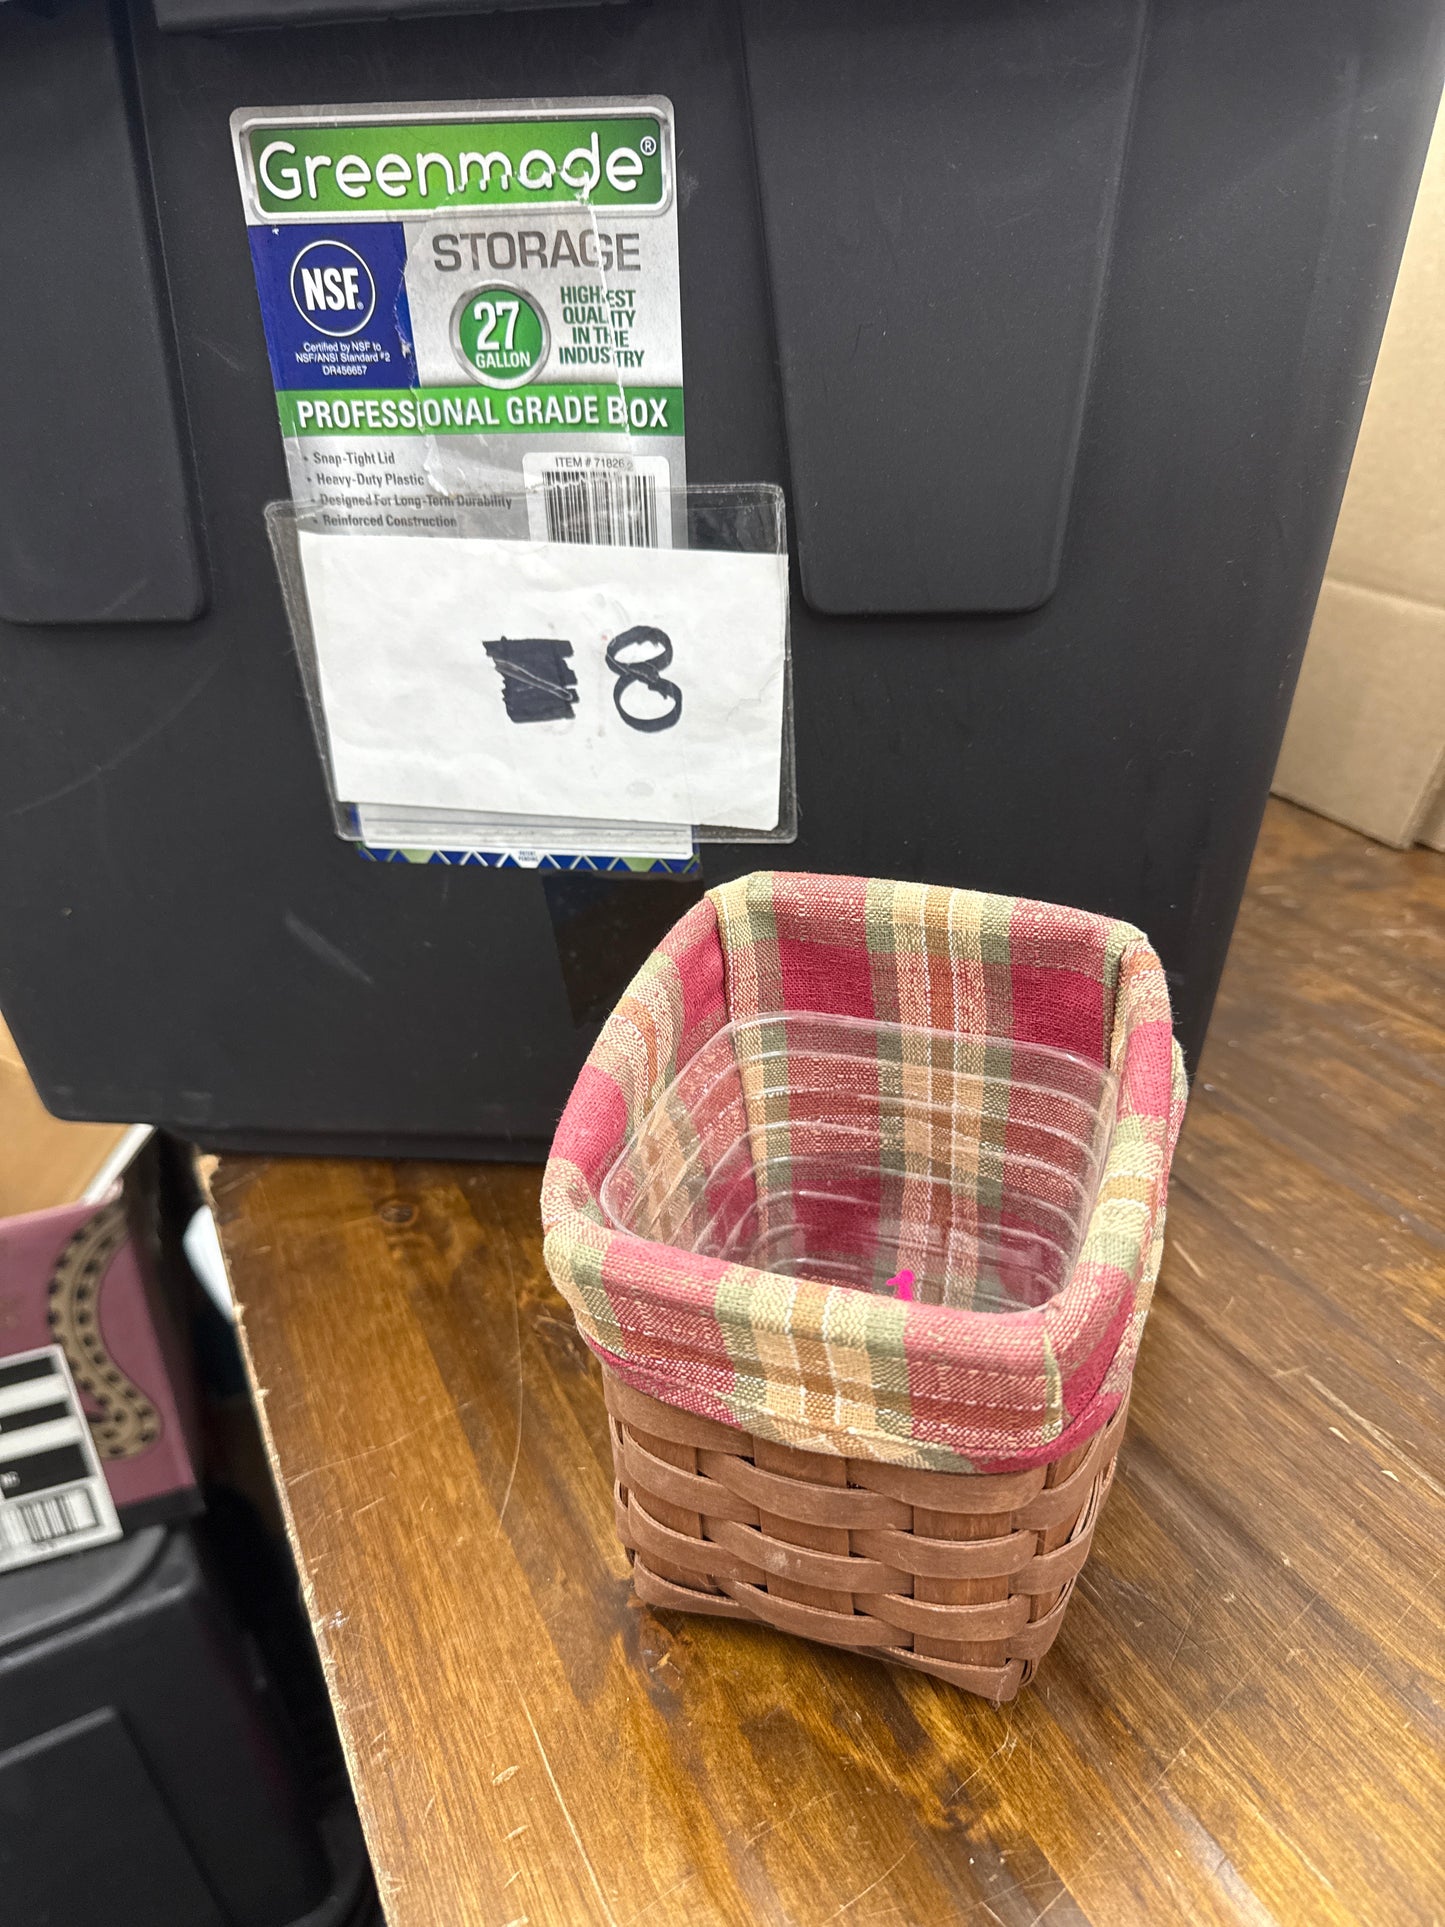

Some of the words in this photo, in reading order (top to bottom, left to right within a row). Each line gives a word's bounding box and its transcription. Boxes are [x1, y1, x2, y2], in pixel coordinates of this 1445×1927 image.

[432, 229, 641, 272] STORAGE
[560, 285, 636, 308] HIGHEST
[474, 301, 520, 351] 27
[562, 306, 636, 328] QUALITY
[572, 326, 590, 344] IN
[593, 326, 629, 348] THE
[303, 341, 338, 352] Certified
[340, 342, 351, 353] by
[351, 341, 370, 352] NSF
[372, 342, 381, 351] to
[295, 352, 339, 363] NSF/ANSI
[340, 352, 379, 362] Standard
[475, 352, 531, 369] GALLON
[559, 346, 645, 368] INDUSTRY
[297, 398, 500, 429] PROFESSIONAL
[506, 396, 599, 425] GRADE
[607, 398, 668, 429] BOX
[314, 451, 376, 467] Snap-Tight
[379, 453, 395, 464] Lid
[555, 456, 582, 467] ITEM
[585, 457, 591, 467] #
[317, 473, 383, 487] Heavy-Duty
[386, 474, 425, 485] Plastic
[320, 493, 372, 508] Designed
[375, 494, 392, 506] For
[395, 495, 454, 508] Long-Term
[457, 495, 512, 508] Durability
[323, 514, 383, 527] Reinforced
[387, 515, 457, 527] Construction
[605, 625, 682, 733] 8
